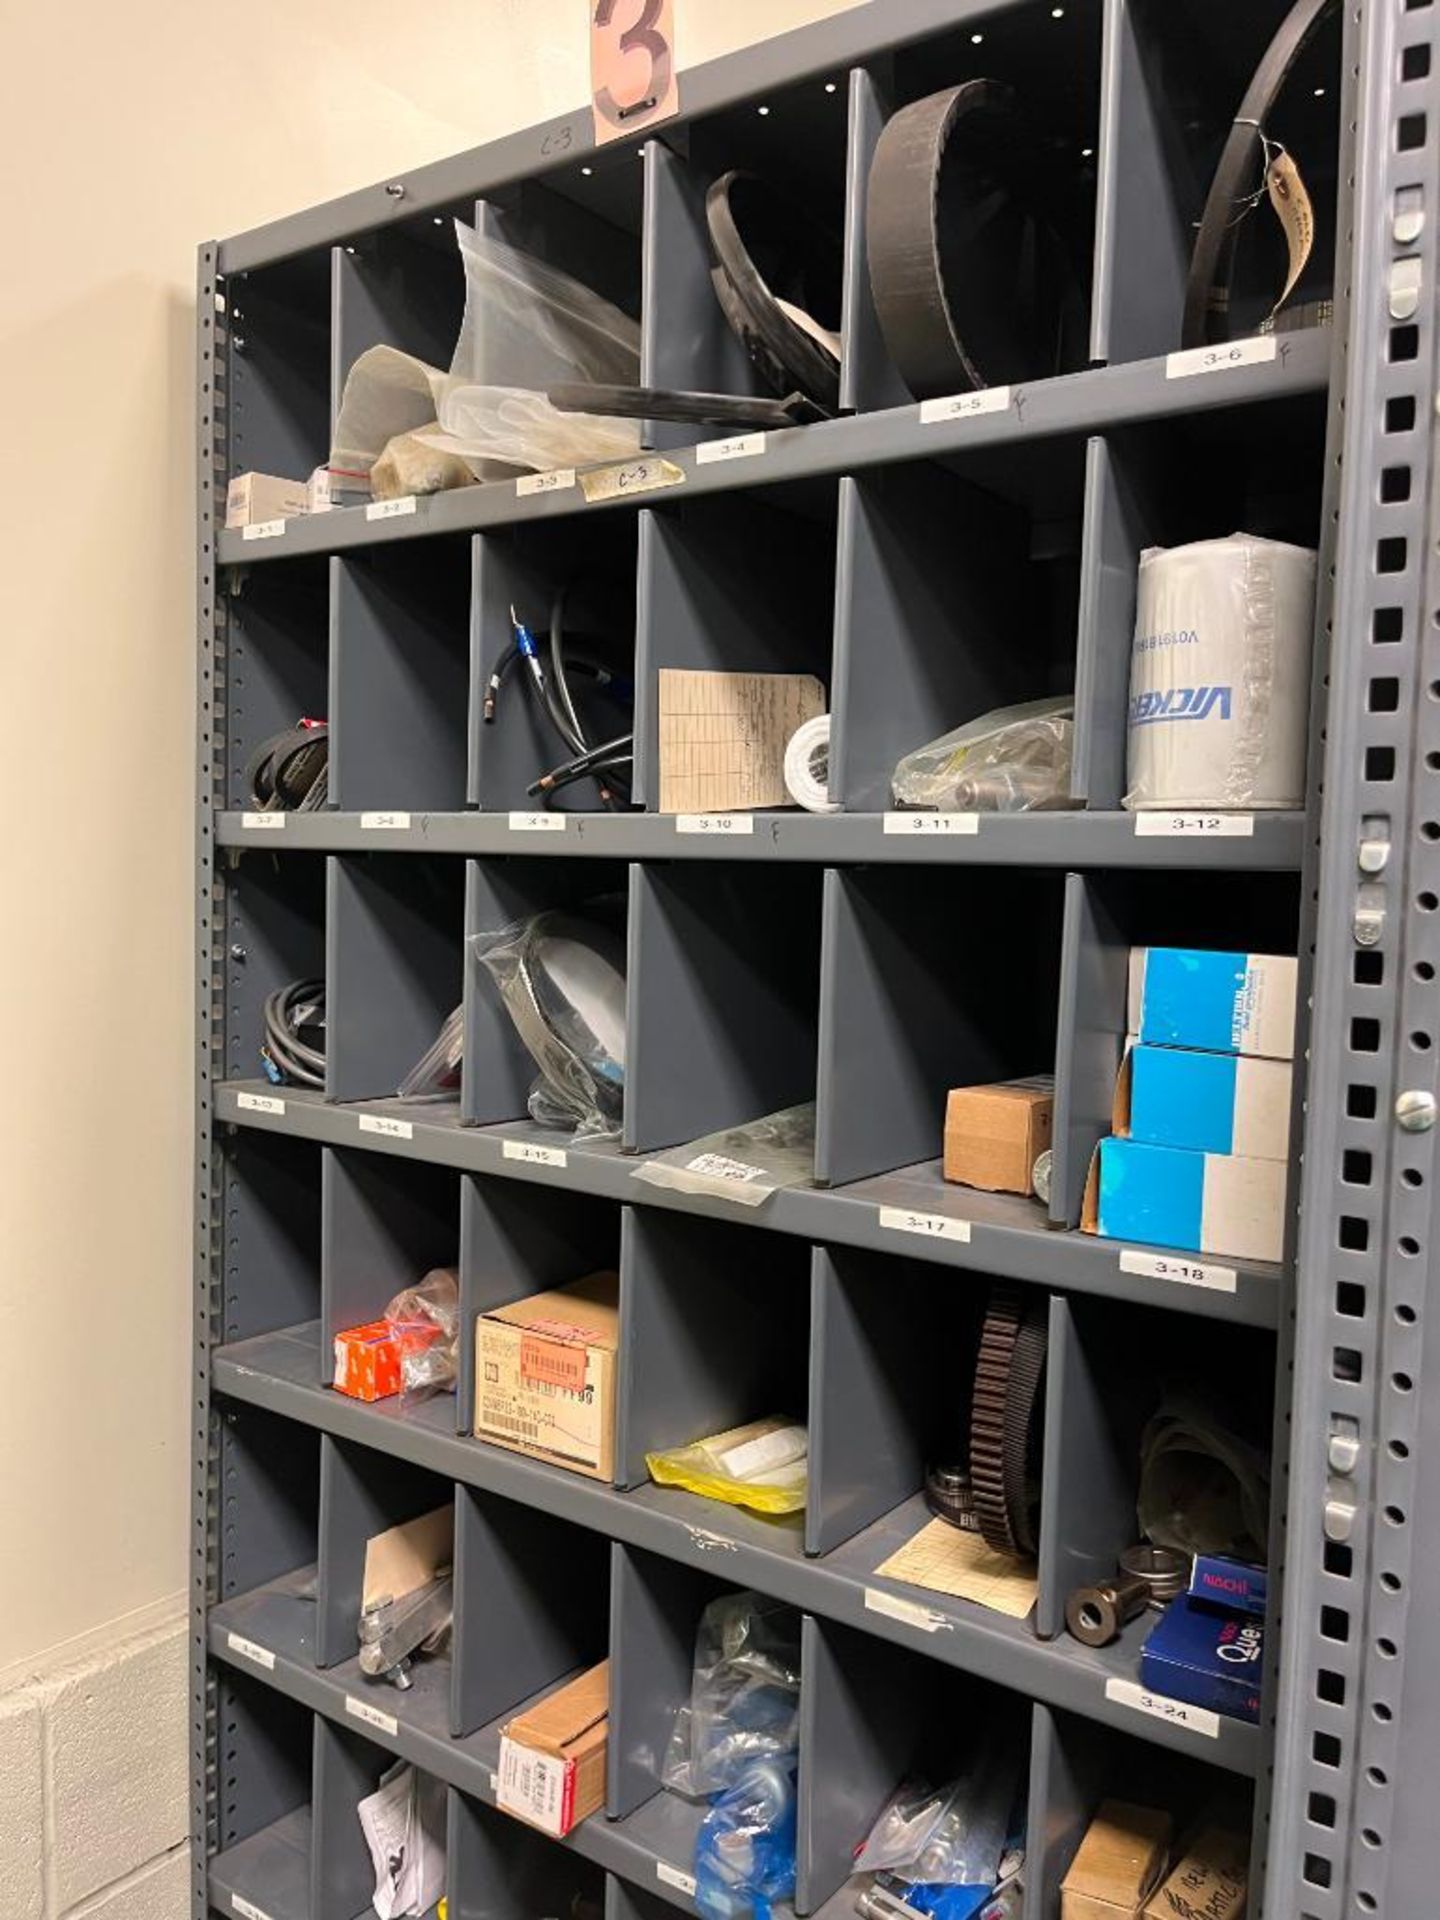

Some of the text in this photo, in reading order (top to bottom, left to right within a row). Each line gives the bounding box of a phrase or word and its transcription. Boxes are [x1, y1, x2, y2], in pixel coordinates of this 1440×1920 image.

[594, 0, 671, 129] 3
[540, 126, 572, 155] C-3
[1203, 348, 1243, 366] 3-6
[950, 398, 981, 413] 3-5
[720, 443, 745, 454] 3-4
[618, 466, 648, 488] C-3
[912, 818, 951, 829] 3-11
[1172, 818, 1220, 830] 3-12
[907, 1216, 945, 1232] 3-17
[1155, 1261, 1204, 1280] 3-18
[1203, 1573, 1248, 1594] NACHI
[1141, 1695, 1188, 1720] 3-24
